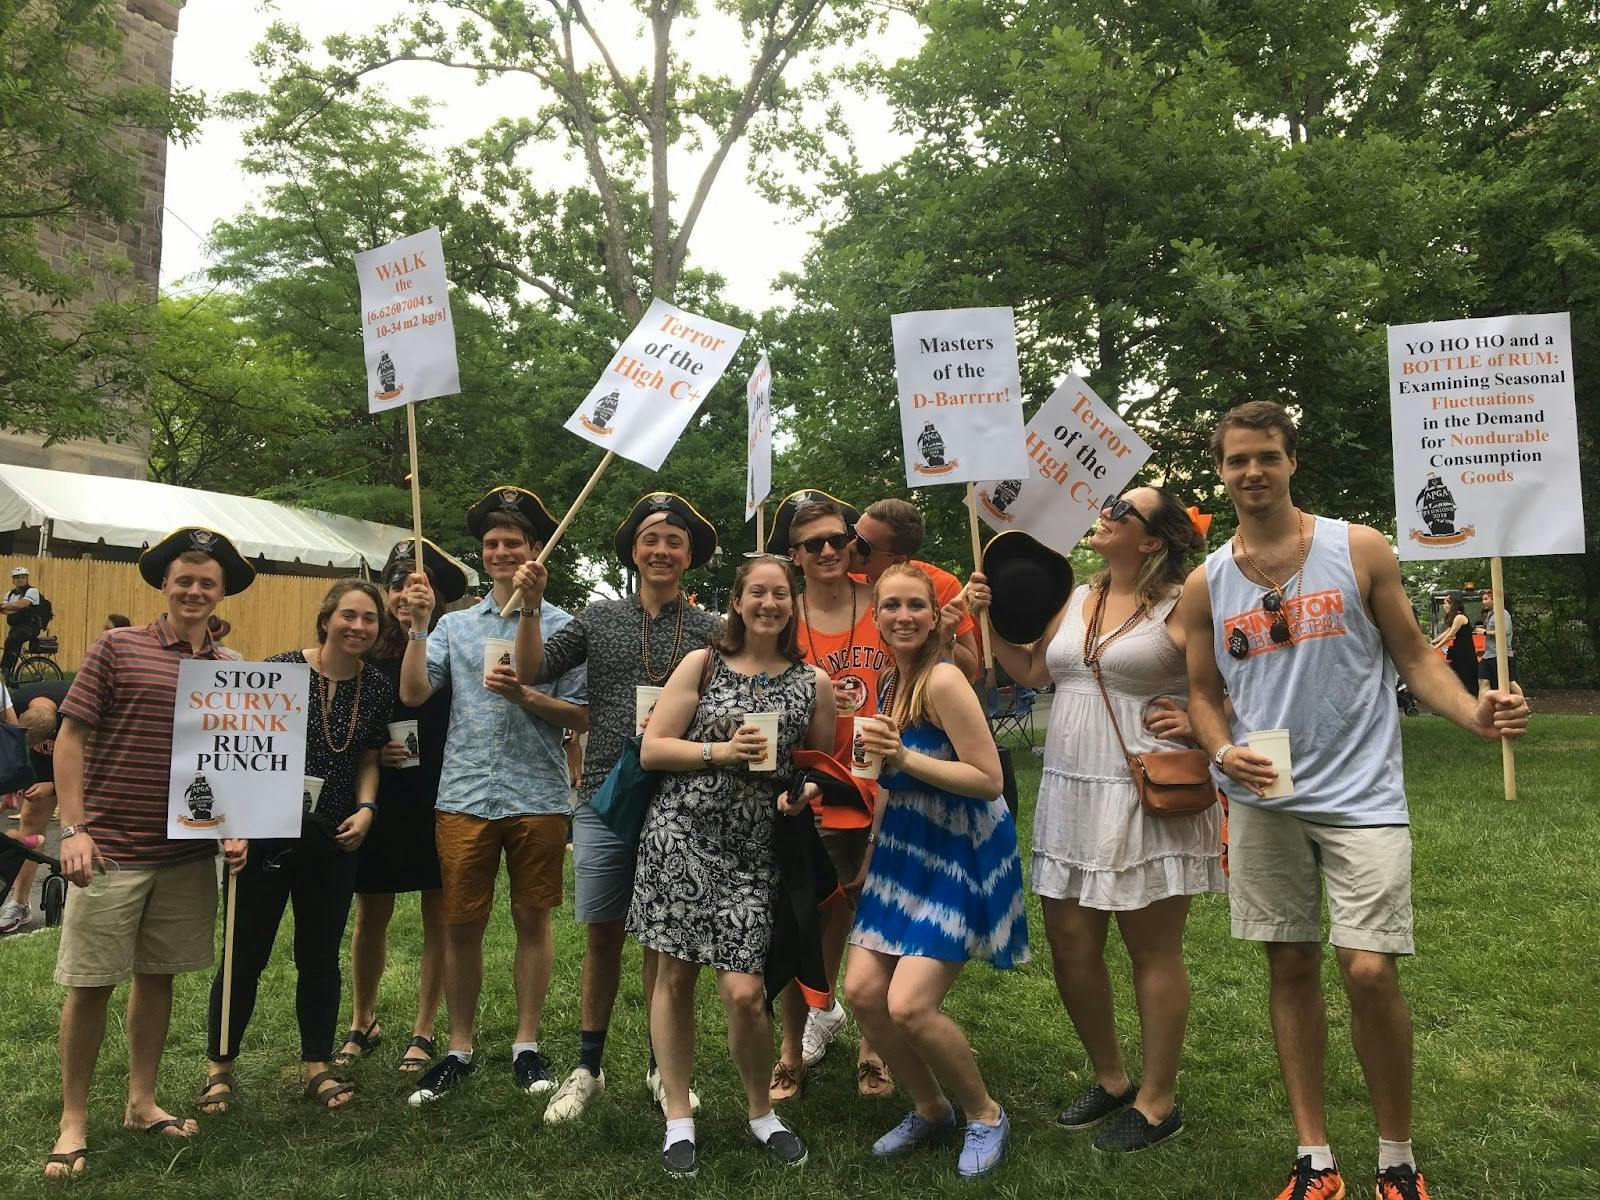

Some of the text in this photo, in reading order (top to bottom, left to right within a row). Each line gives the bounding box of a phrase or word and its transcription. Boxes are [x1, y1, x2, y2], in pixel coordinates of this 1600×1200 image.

[375, 251, 427, 282] WALK
[395, 278, 412, 294] the
[376, 320, 401, 338] 10-34
[403, 316, 419, 330] m2
[658, 313, 726, 352] Terror
[919, 336, 994, 355] Masters
[1406, 333, 1553, 355] YO HO HO and a
[644, 342, 704, 376] of the
[1402, 351, 1559, 375] BOTTLE of RUM:
[612, 355, 701, 403] High C+
[933, 362, 985, 381] of the
[1399, 370, 1566, 394] Examining Seasonal
[912, 387, 1010, 409] D-Barrrrr!
[1431, 392, 1536, 410] Fluctuations
[1071, 391, 1132, 459] Terror
[1423, 410, 1545, 430] in the Demand
[1421, 430, 1550, 449] for Nondurable
[1054, 425, 1106, 480] of the
[1430, 449, 1542, 468] Consumption
[1025, 431, 1069, 486] High
[1070, 480, 1099, 511] C+
[1461, 469, 1514, 485] Goods
[1425, 489, 1448, 500] APGA
[214, 670, 282, 689] STOP
[189, 691, 302, 715] SCURVY,
[201, 713, 288, 732] DRINK
[213, 734, 273, 753] RUM
[197, 753, 289, 772] PUNCH
